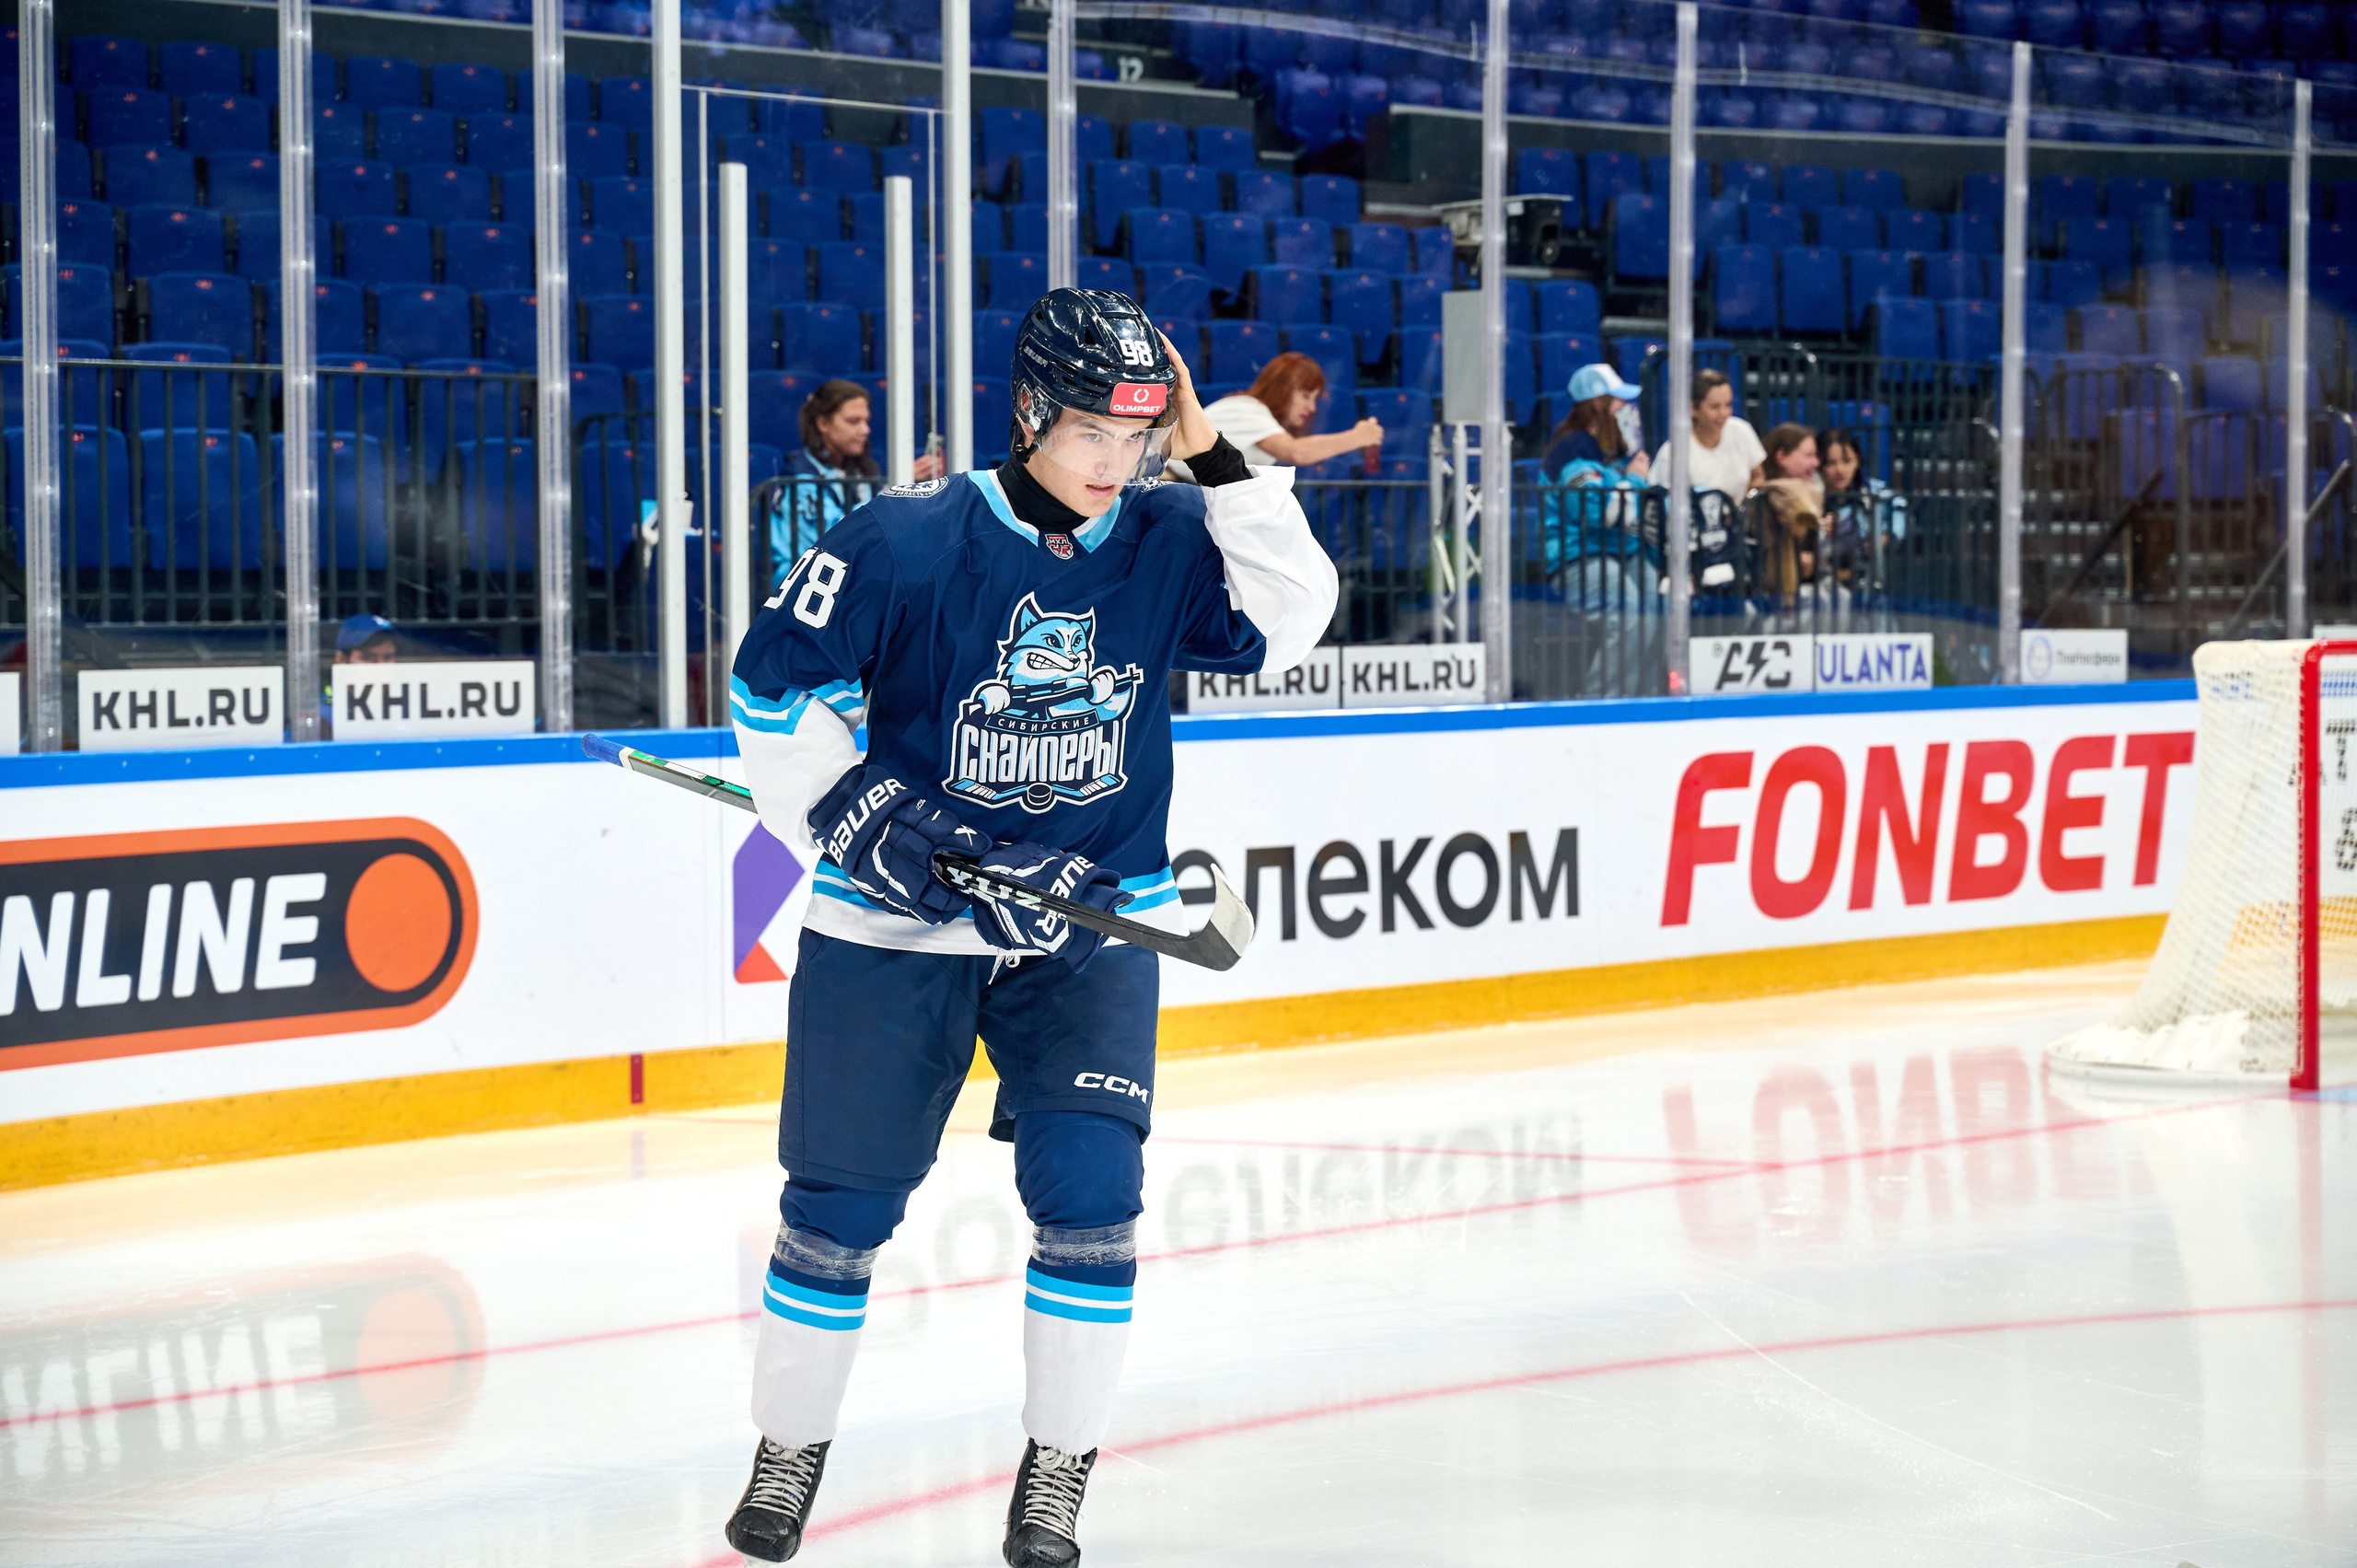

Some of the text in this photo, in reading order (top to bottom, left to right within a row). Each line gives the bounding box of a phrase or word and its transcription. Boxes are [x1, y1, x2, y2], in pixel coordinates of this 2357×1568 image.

[1119, 339, 1155, 367] 98
[1112, 403, 1161, 412] OLIMPBET
[1200, 664, 1329, 697] KHL.RU
[1353, 658, 1477, 694] KHL.RU
[1818, 644, 1927, 683] ULANTA
[92, 686, 271, 730] KHL.RU
[346, 680, 521, 721] KHL.RU
[997, 716, 1090, 731] СИБИРСКИЕ
[828, 778, 908, 868] BAUER
[1660, 730, 2196, 928] FONBET
[0, 872, 327, 1013] NLINE
[1074, 1072, 1150, 1104] CCM
